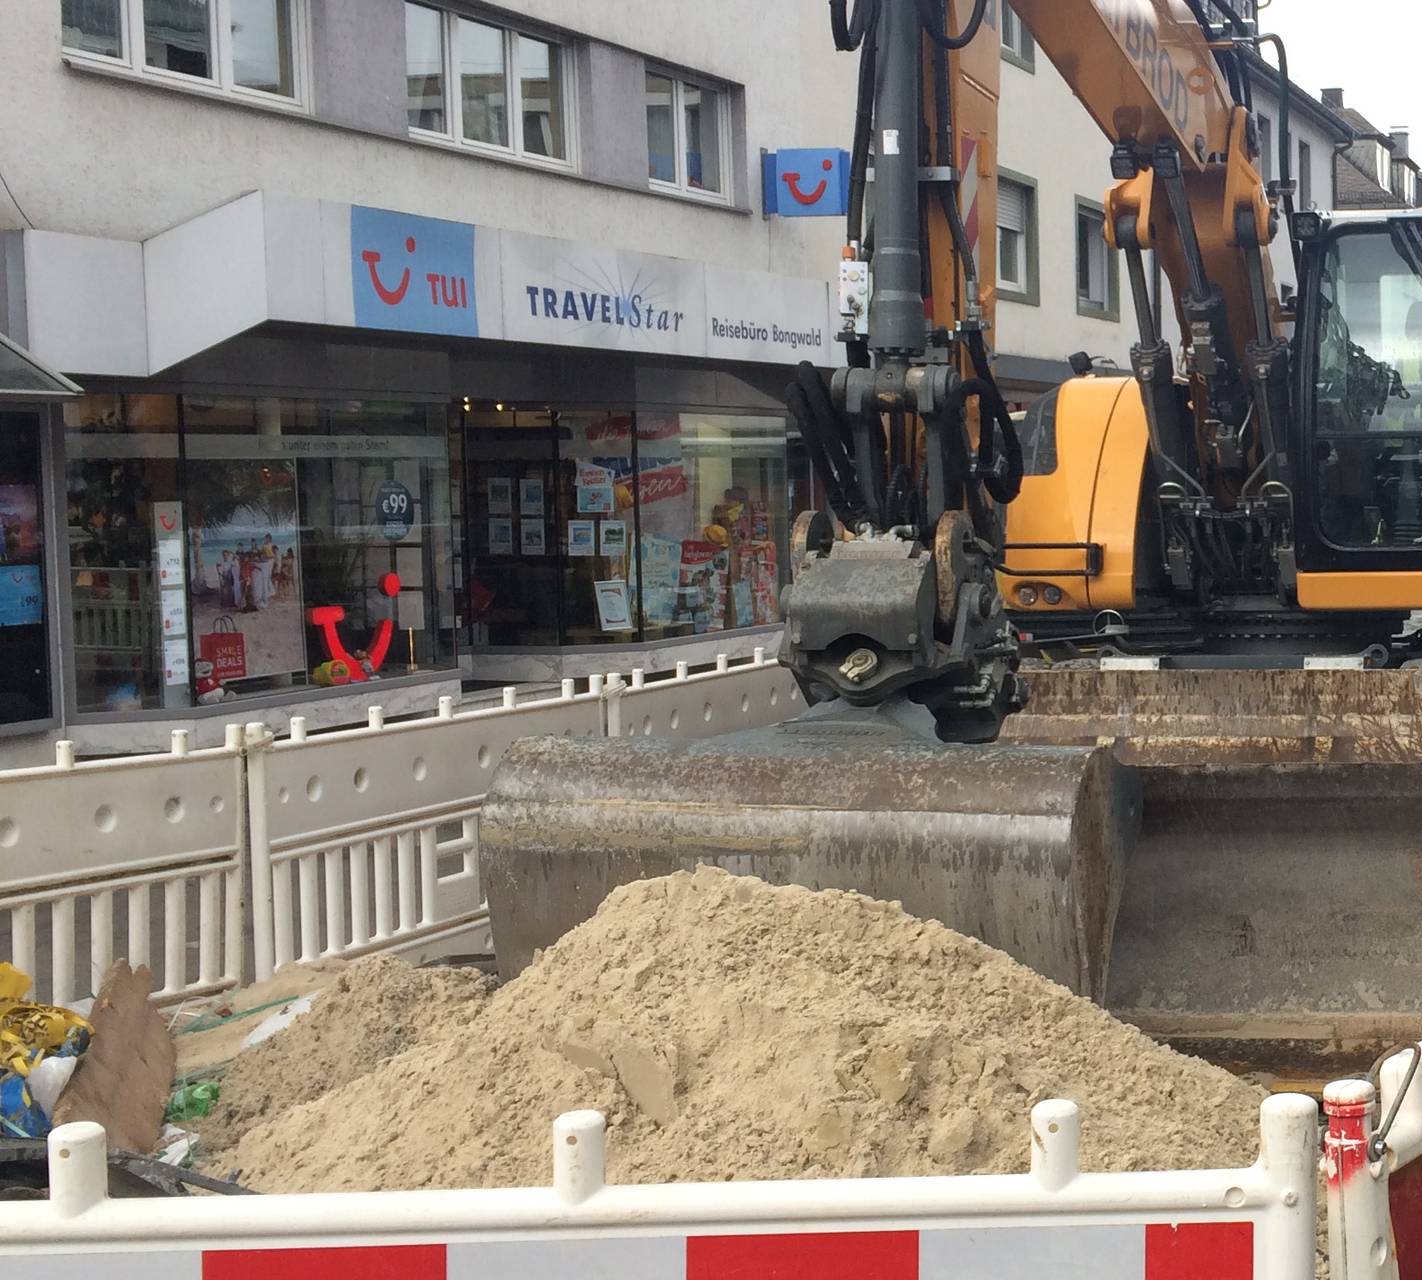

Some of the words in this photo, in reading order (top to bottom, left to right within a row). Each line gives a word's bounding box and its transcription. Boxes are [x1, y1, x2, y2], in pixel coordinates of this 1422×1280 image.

[426, 272, 467, 309] TUI
[712, 317, 768, 342] Reisebüro
[772, 324, 822, 349] Bongwald
[382, 494, 408, 514] €99
[216, 656, 242, 668] DEALS
